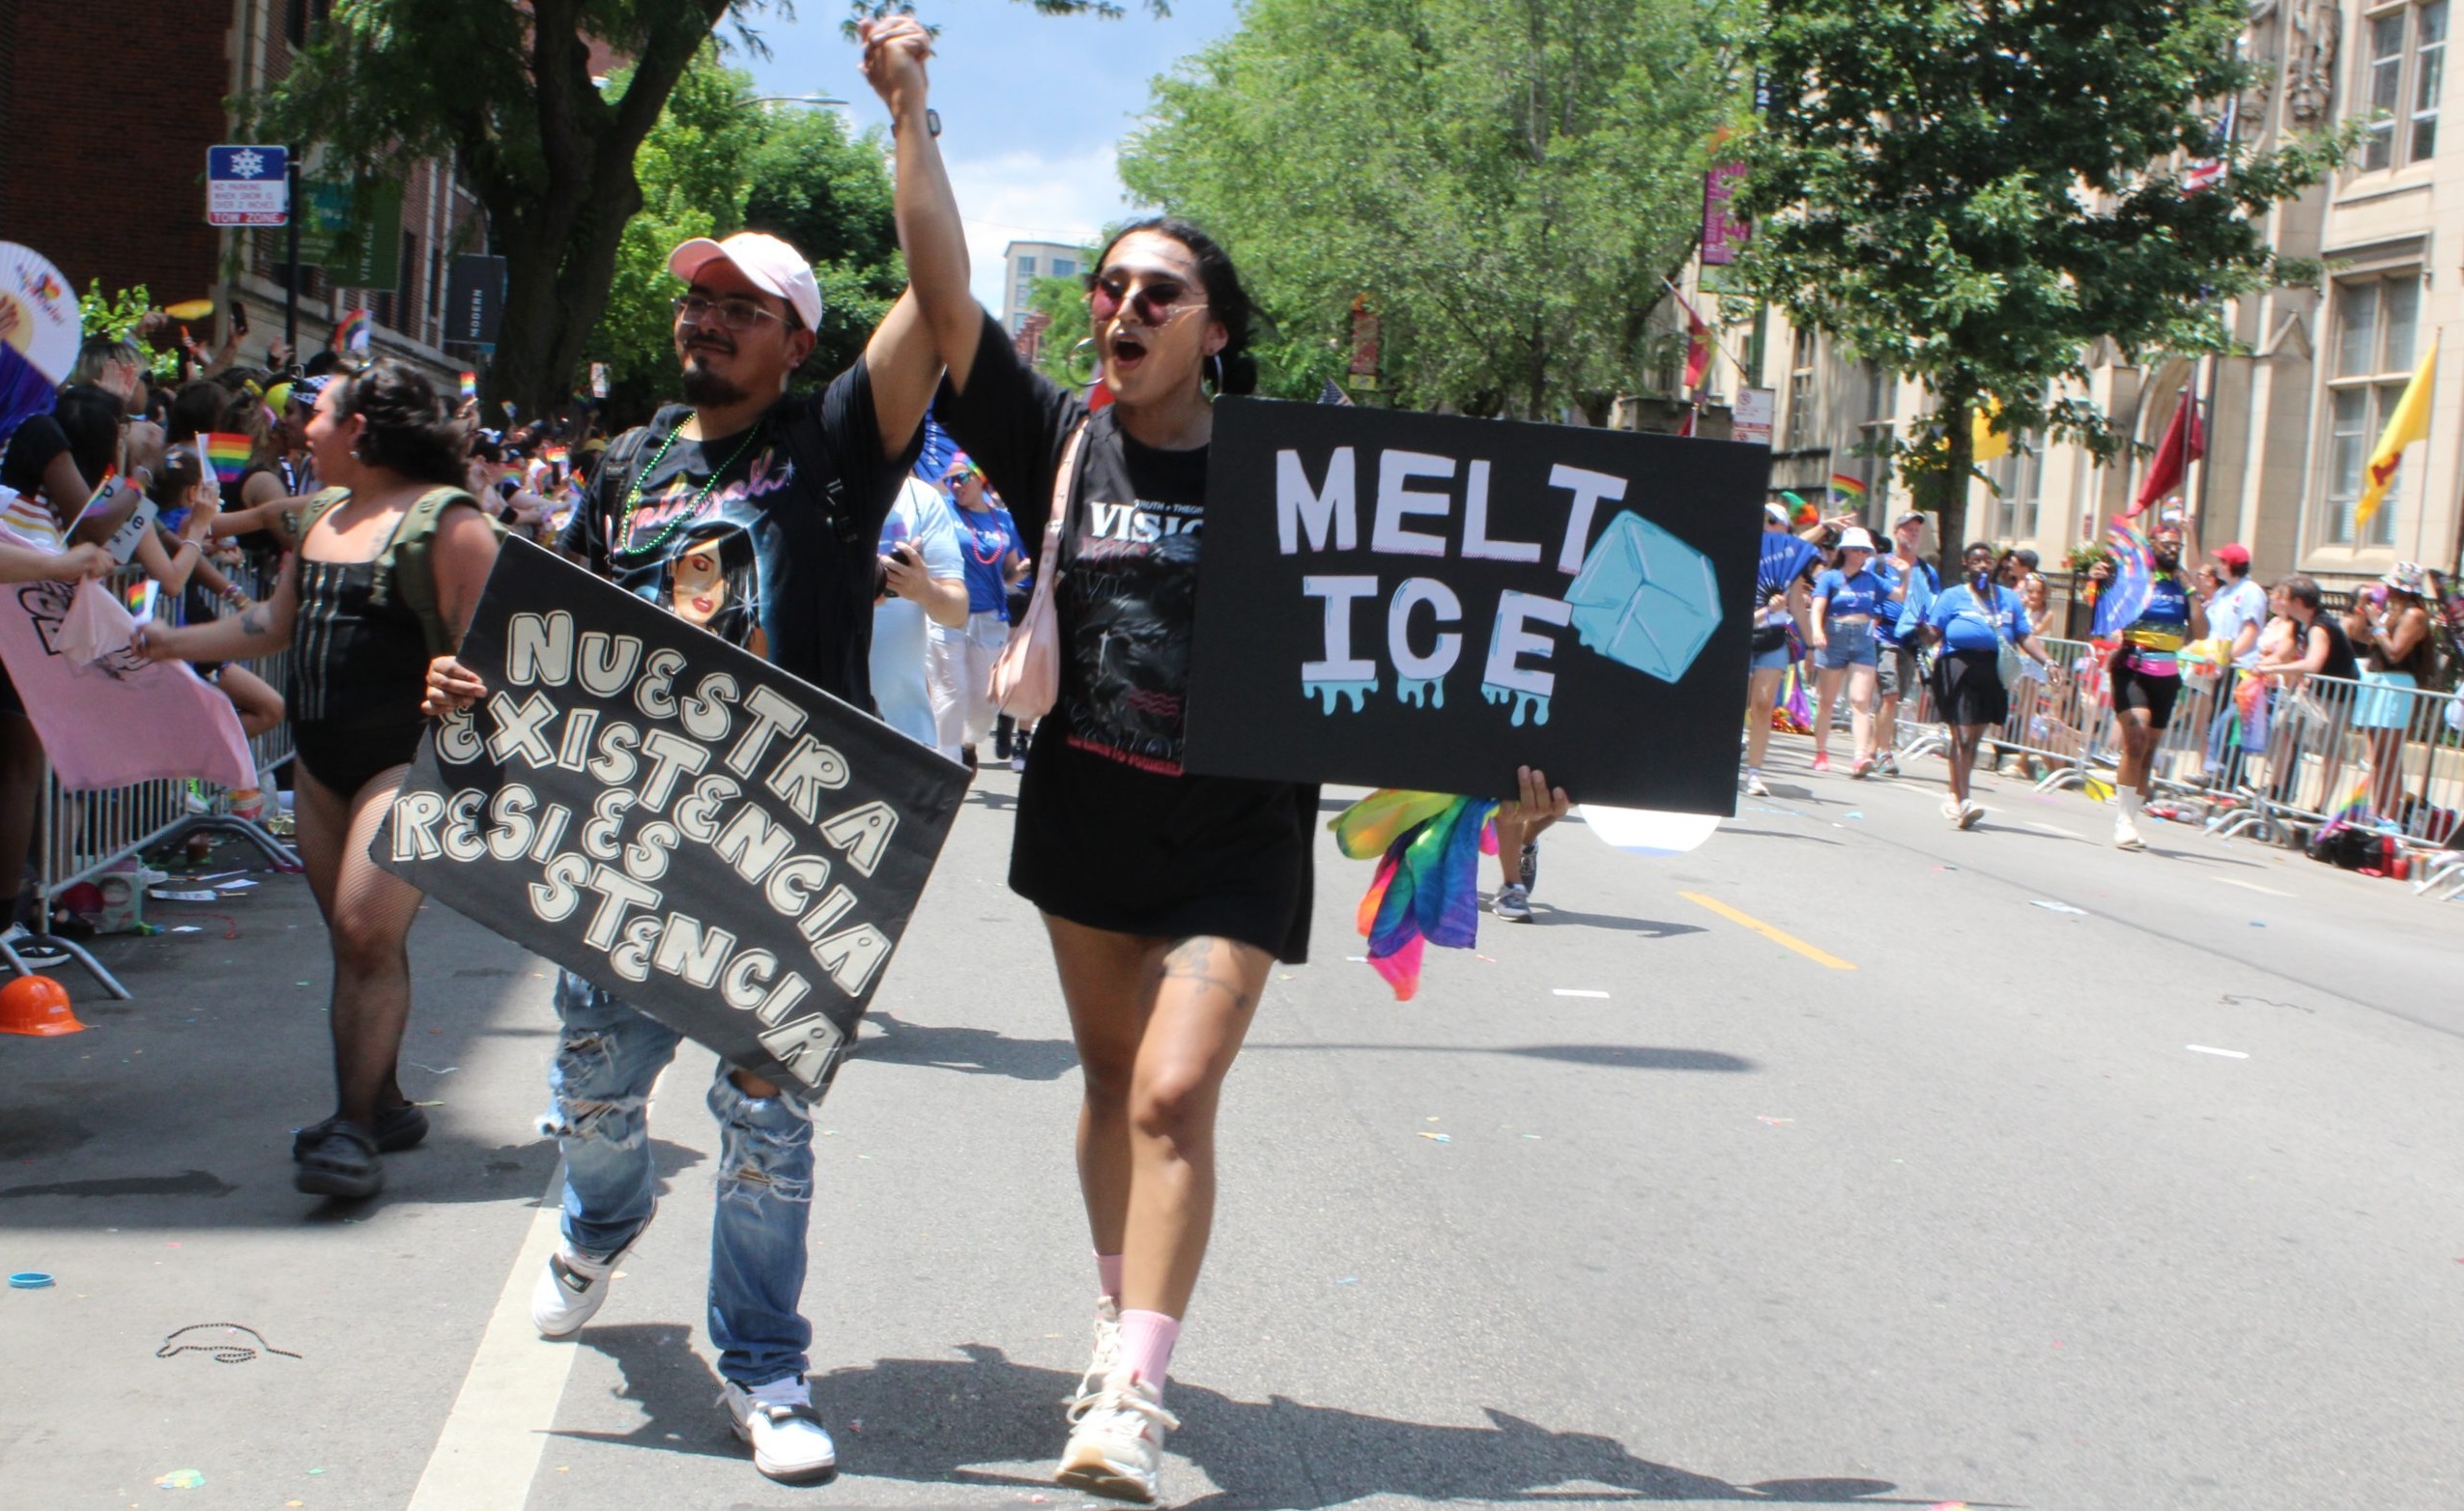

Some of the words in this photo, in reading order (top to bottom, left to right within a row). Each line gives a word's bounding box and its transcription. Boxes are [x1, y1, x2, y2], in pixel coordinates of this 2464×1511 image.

[215, 213, 239, 223] TOW
[245, 213, 279, 223] ZONE
[470, 289, 483, 338] MODERN
[1276, 446, 1628, 575] MELT
[1302, 576, 1573, 698] ICE
[506, 610, 899, 877] NUESTRA
[436, 690, 891, 997] EXISTENCIA
[582, 788, 679, 881] ES
[529, 852, 845, 1088] STENCIA
